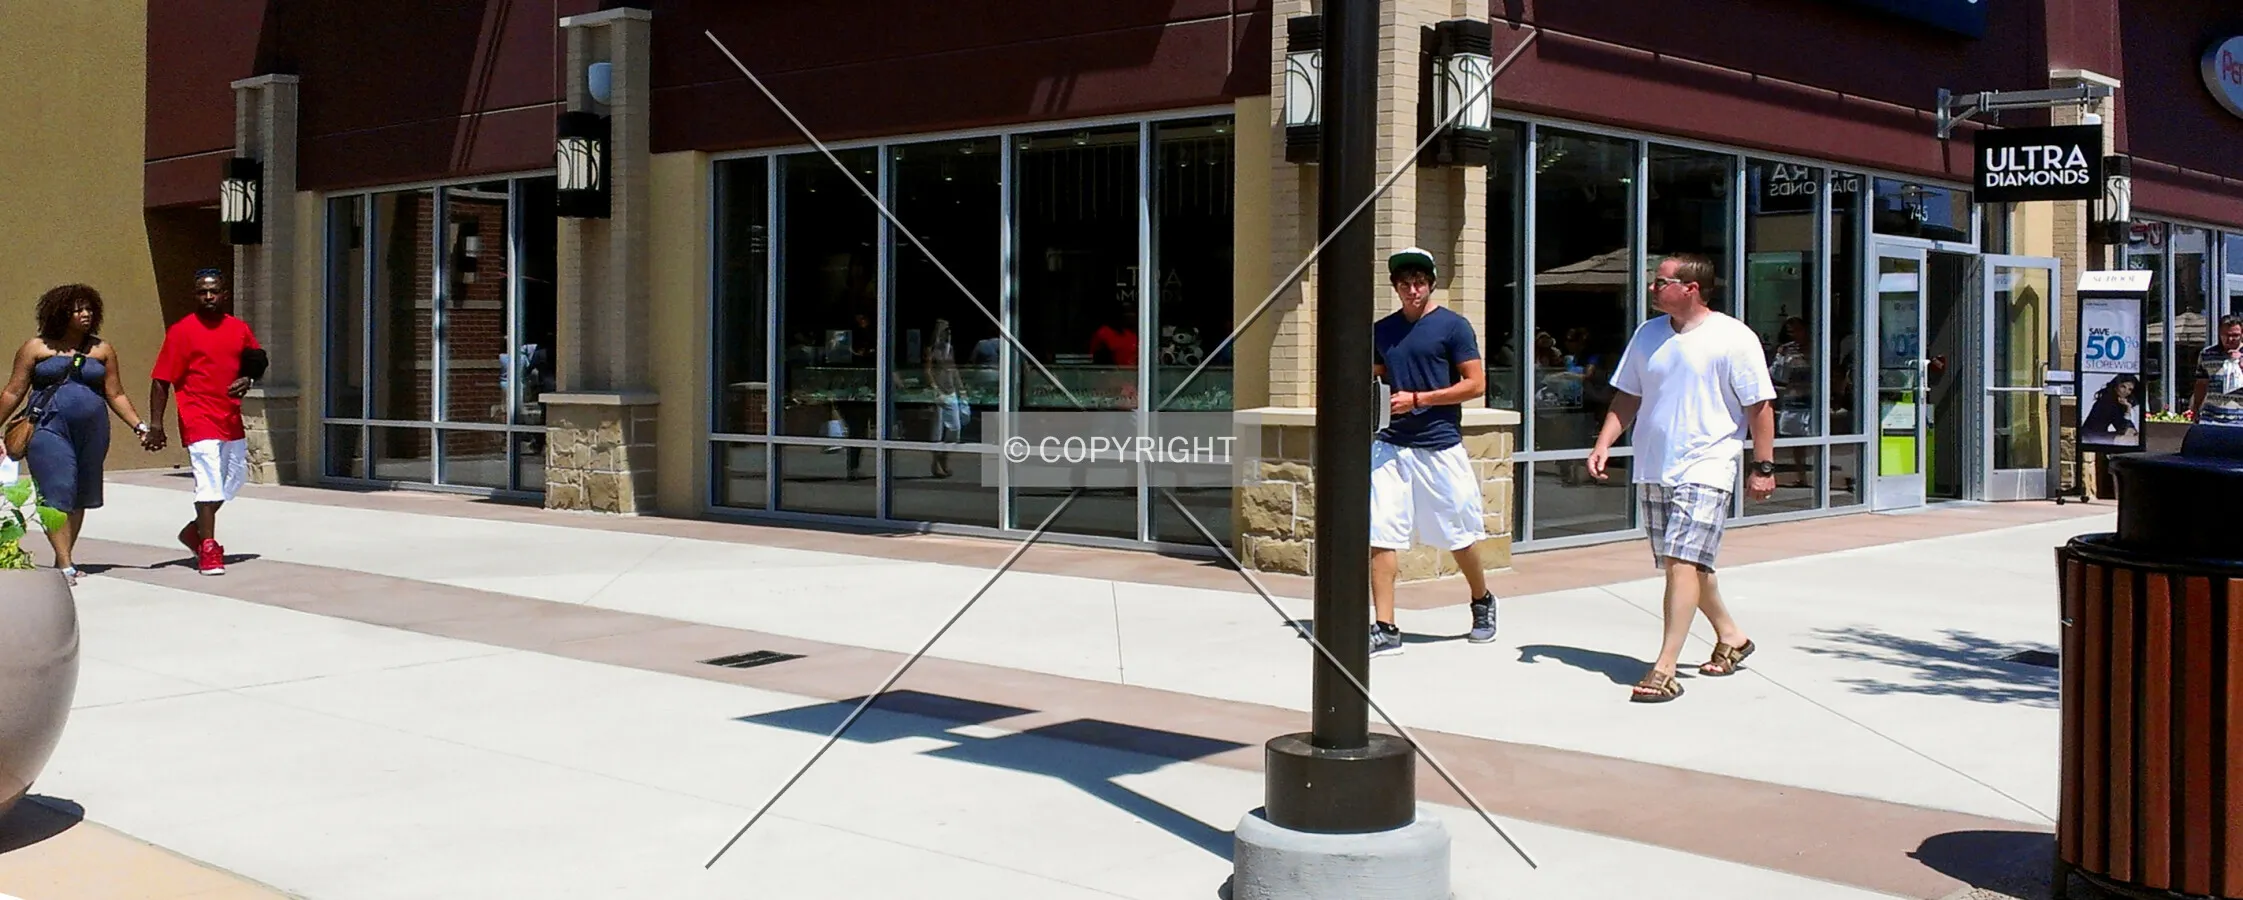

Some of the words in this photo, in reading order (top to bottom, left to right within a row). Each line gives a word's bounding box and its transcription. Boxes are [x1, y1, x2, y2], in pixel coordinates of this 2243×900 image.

[1986, 144, 2088, 172] ULTRA
[1985, 168, 2090, 188] DIAMONDS
[1910, 203, 1928, 222] 745
[2088, 327, 2110, 336] SAVE
[2085, 359, 2138, 370] STOREWIDE
